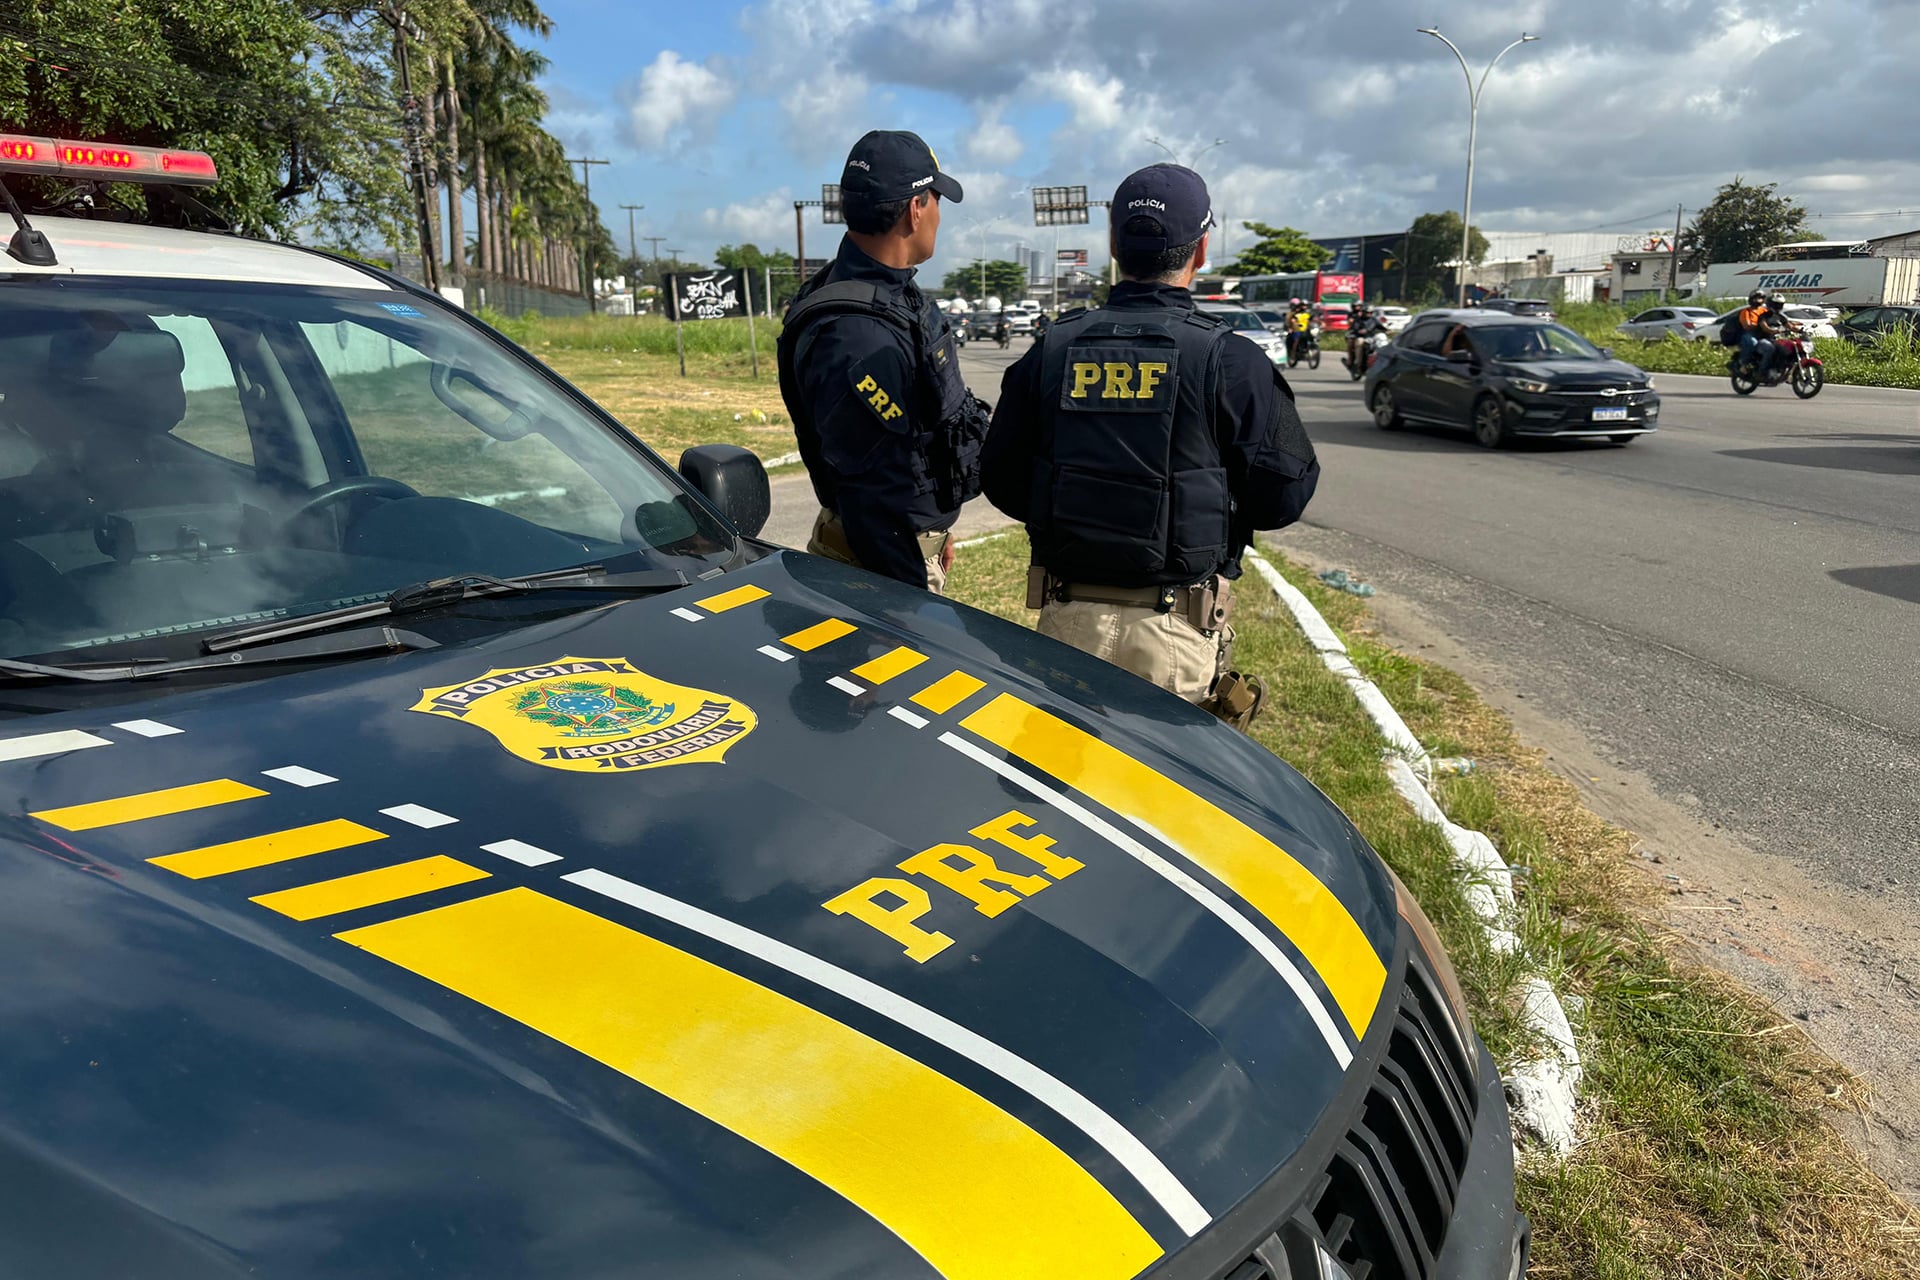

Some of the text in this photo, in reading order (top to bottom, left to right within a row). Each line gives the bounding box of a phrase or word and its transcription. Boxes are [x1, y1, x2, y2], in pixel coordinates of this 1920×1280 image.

[1757, 273, 1823, 288] TECMAR
[856, 374, 904, 421] PRF
[1070, 362, 1168, 399] PRF
[622, 728, 739, 767] FEDERAL
[820, 809, 1087, 964] PRF
